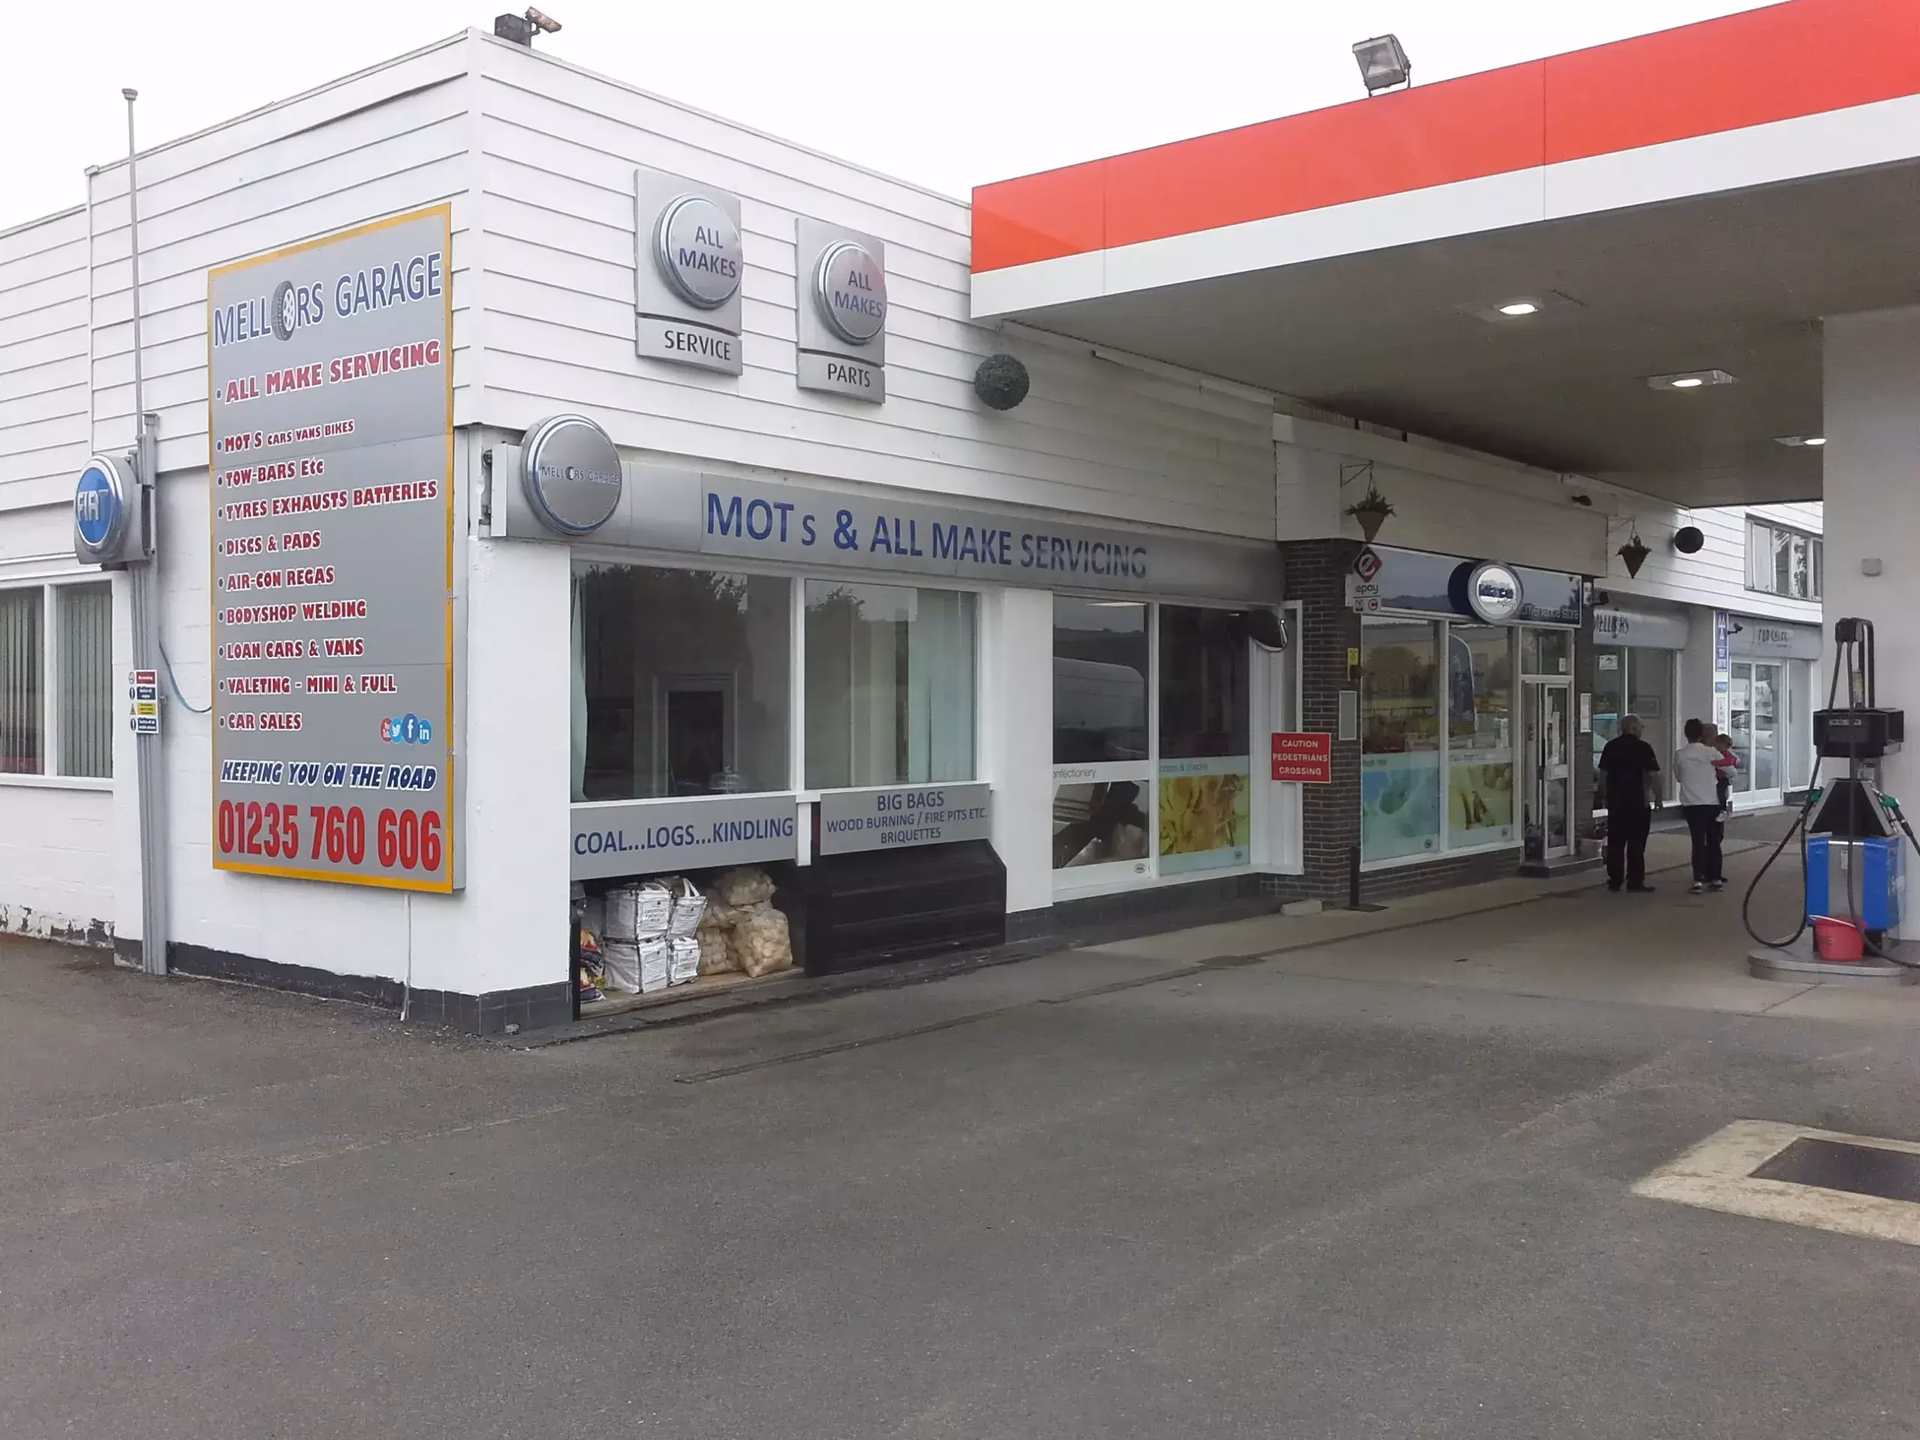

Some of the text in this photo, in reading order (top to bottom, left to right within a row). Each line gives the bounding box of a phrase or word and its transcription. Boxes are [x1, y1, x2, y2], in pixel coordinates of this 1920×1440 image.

[695, 226, 723, 249] ALL
[679, 248, 736, 278] MAKES
[335, 252, 441, 318] GARAGE
[848, 270, 872, 291] ALL
[835, 291, 882, 318] MAKES
[664, 330, 731, 361] SERVICE
[225, 340, 440, 404] ALL MAKE SERVICING
[827, 363, 870, 388] PARTS
[267, 430, 292, 445] CARS
[296, 425, 321, 441] VANS
[324, 420, 355, 436] BIKES
[225, 461, 295, 487] TOW-BARS
[77, 489, 108, 522] FIAT
[226, 480, 437, 520] TYRES EXHAUSTS BATTERIES
[226, 531, 321, 555] DISCS & PADS
[833, 509, 858, 551] &
[870, 515, 922, 556] ALL
[932, 522, 1011, 565] MAKE
[1020, 533, 1146, 578] SERVICING
[226, 567, 334, 591] AIR-CON REGAS
[1355, 584, 1379, 595] epay
[226, 601, 366, 624] BODYSHOP WELDING
[226, 638, 364, 659] LOAN CARS & VANS
[227, 677, 290, 694] VALETING
[307, 675, 338, 693] MINI
[344, 676, 355, 692] &
[360, 675, 397, 692] FULL
[228, 713, 302, 730] CAR SALES
[1282, 740, 1318, 748] CAUTION
[1272, 753, 1328, 762] PEDESTRIANS
[221, 760, 436, 791] KEEPING YOU ON THE ROAD
[1279, 766, 1322, 775] CROSSING
[877, 791, 944, 812] BIG BAGS
[827, 819, 863, 832] WOOD
[867, 814, 914, 829] BURNING
[925, 811, 945, 824] FIRE
[947, 809, 967, 821] PITS
[218, 799, 441, 871] 01235 760 606
[881, 827, 941, 844] BRIQUETTES
